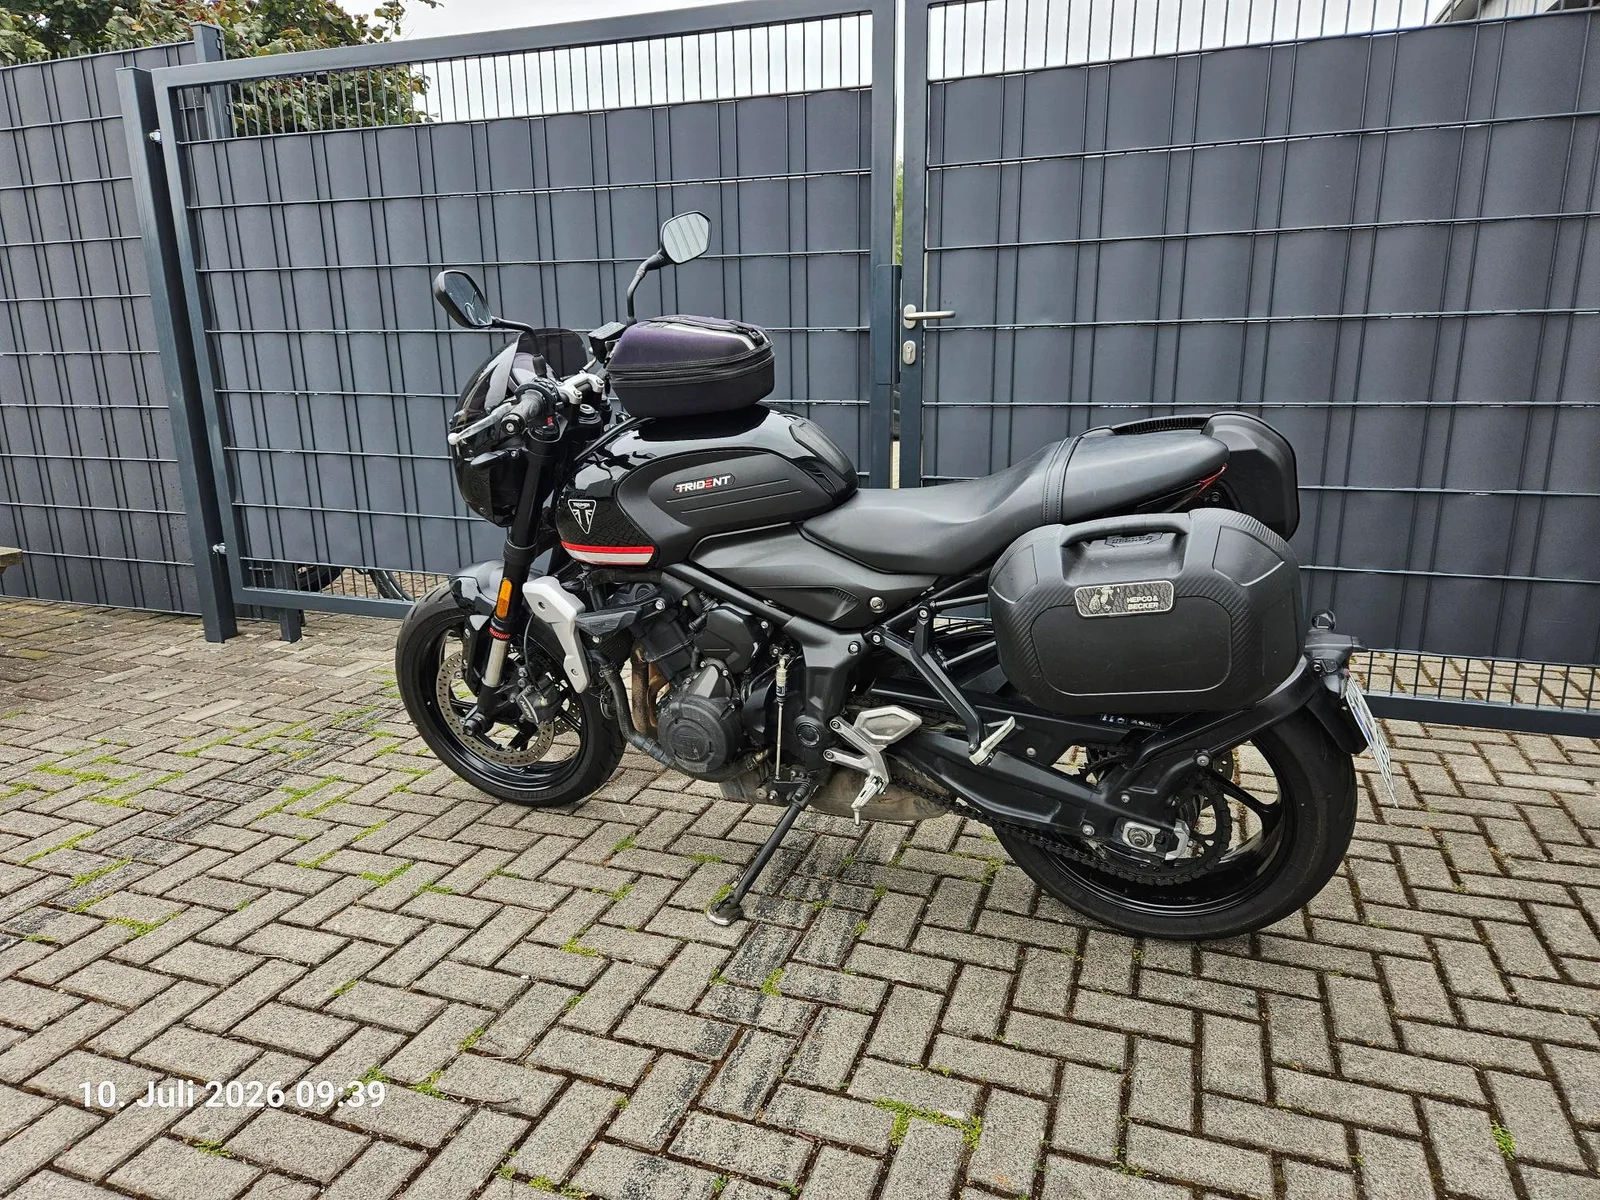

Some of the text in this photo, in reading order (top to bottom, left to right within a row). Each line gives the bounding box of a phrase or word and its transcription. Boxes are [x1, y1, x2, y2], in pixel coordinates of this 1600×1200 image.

[675, 476, 731, 493] TRIDENT
[1126, 595, 1153, 603] HEPCO
[1127, 602, 1159, 610] BECKER
